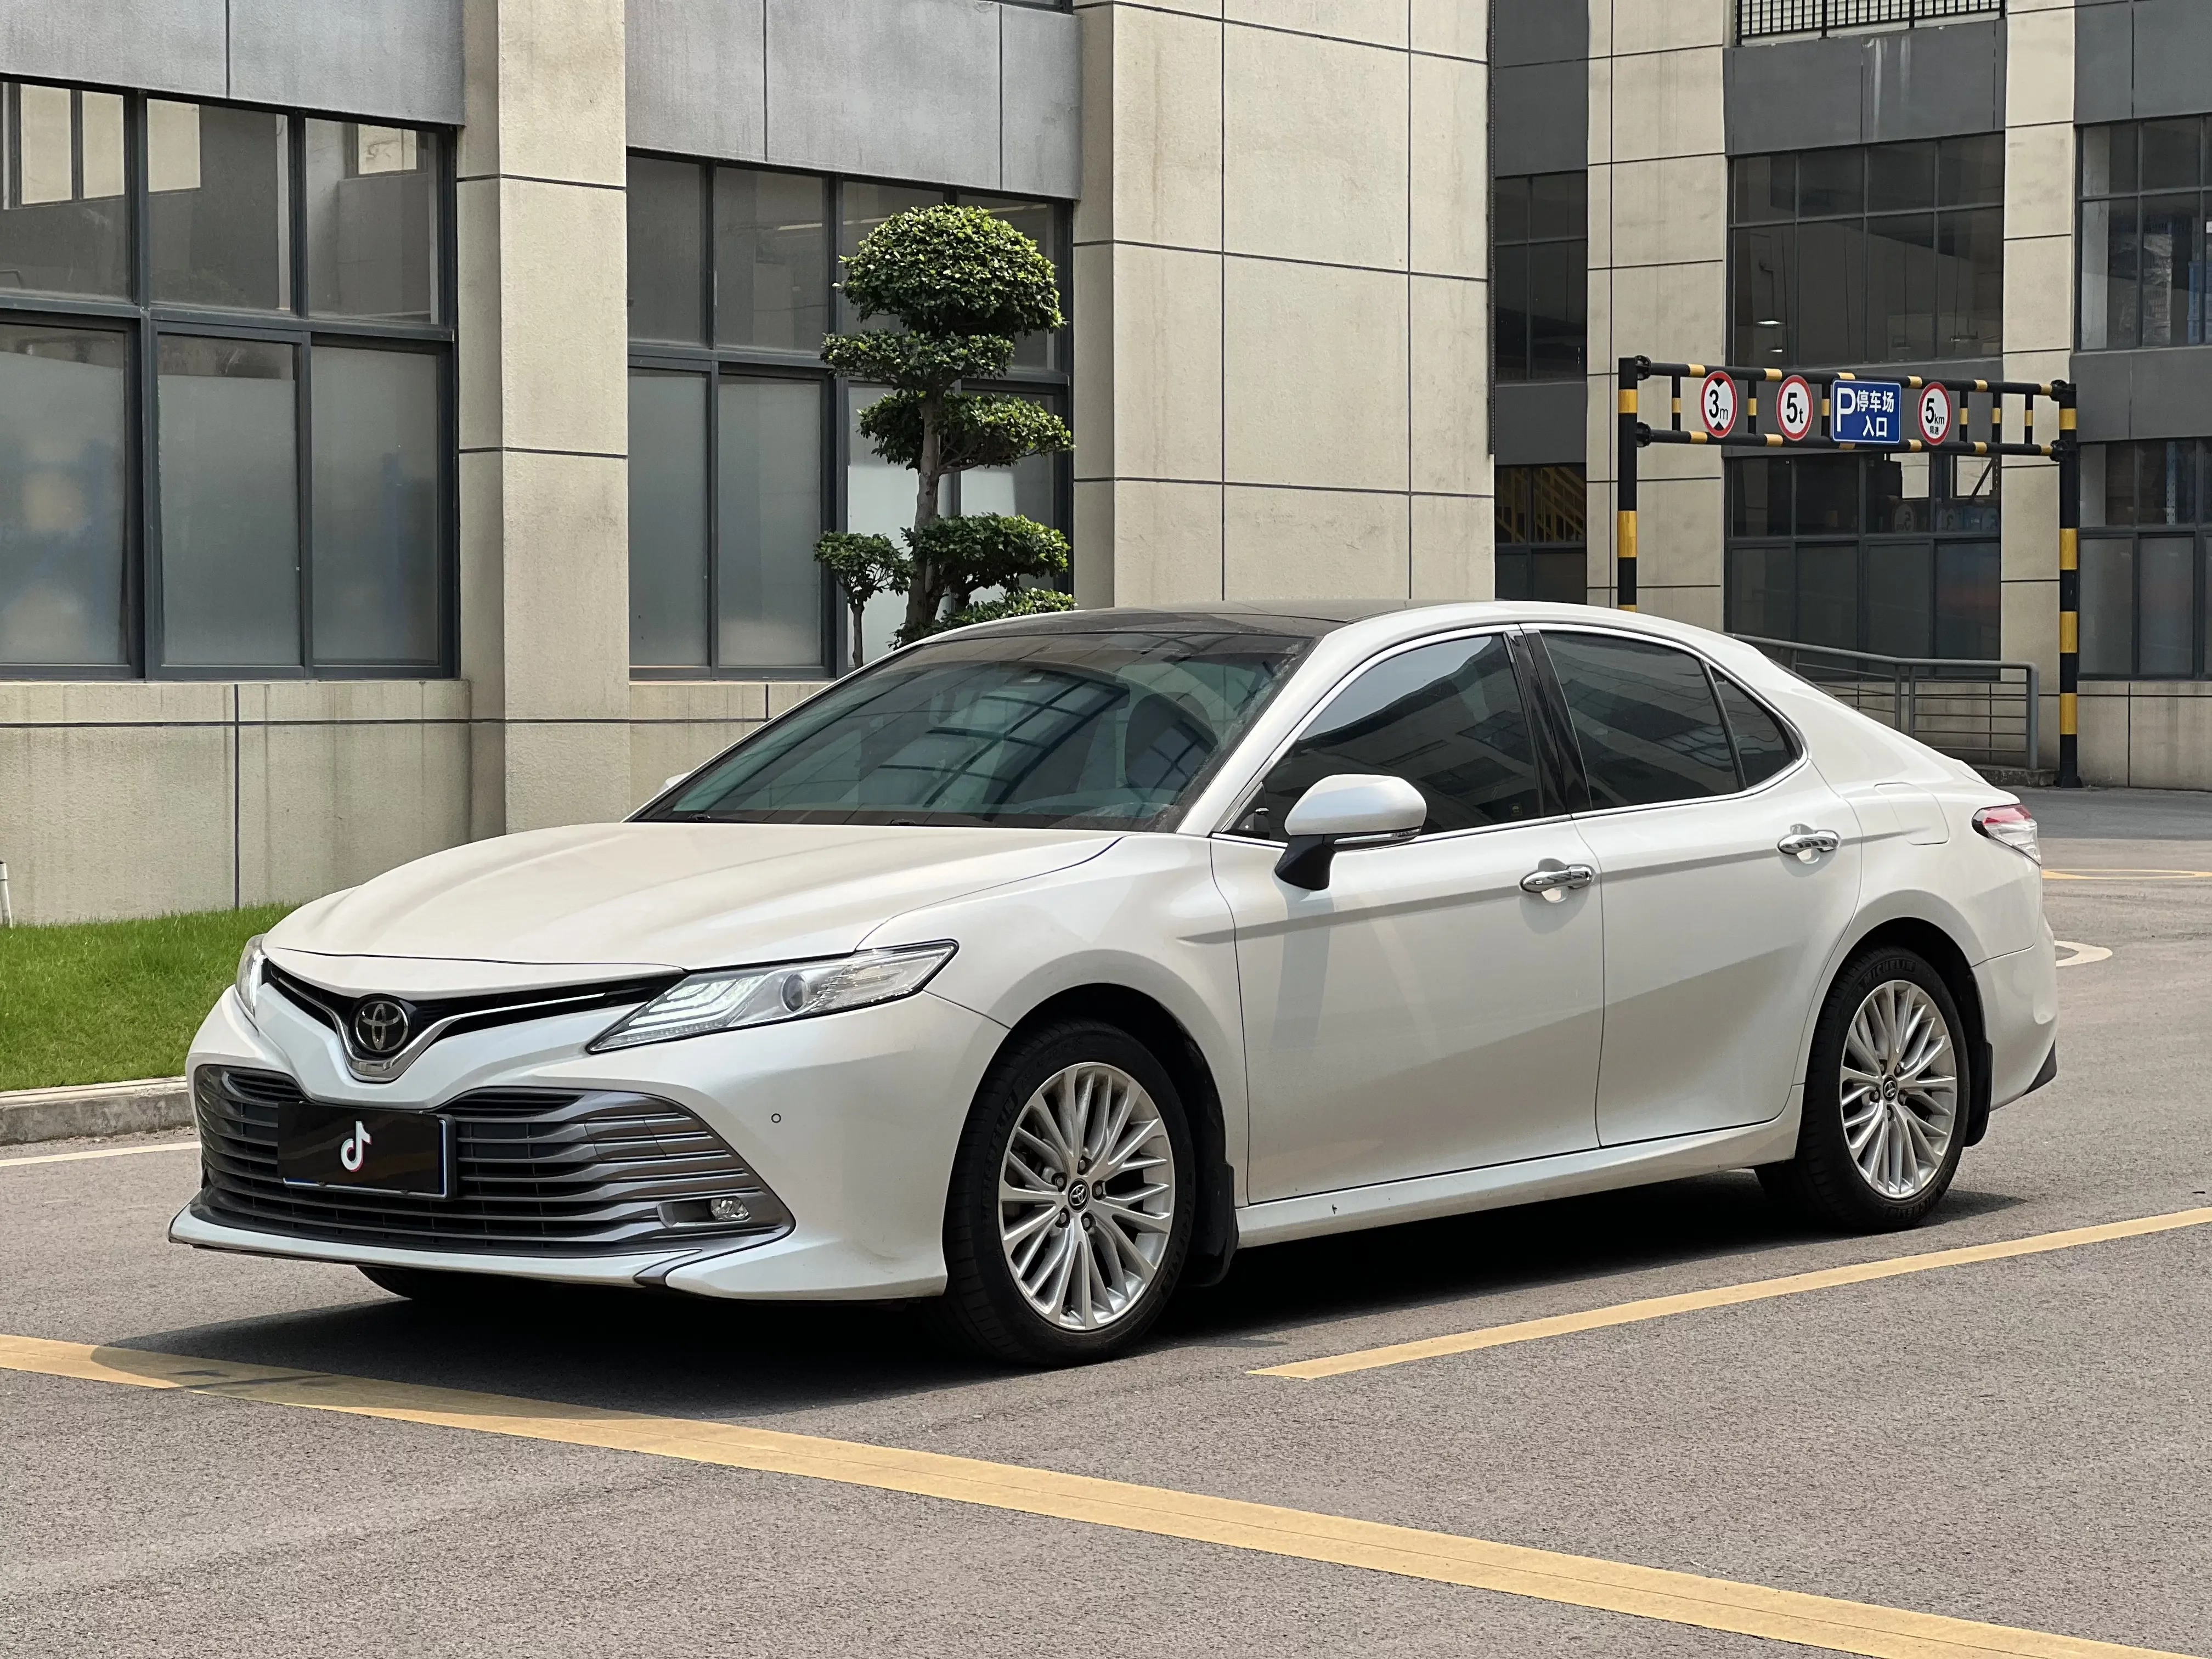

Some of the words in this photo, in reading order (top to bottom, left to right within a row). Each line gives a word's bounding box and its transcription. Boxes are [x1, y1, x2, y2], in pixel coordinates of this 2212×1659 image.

[1837, 387, 1856, 432] P
[1857, 390, 1894, 413] 停车场
[1863, 415, 1887, 437] 入口
[1863, 959, 1915, 986] MICHELIN
